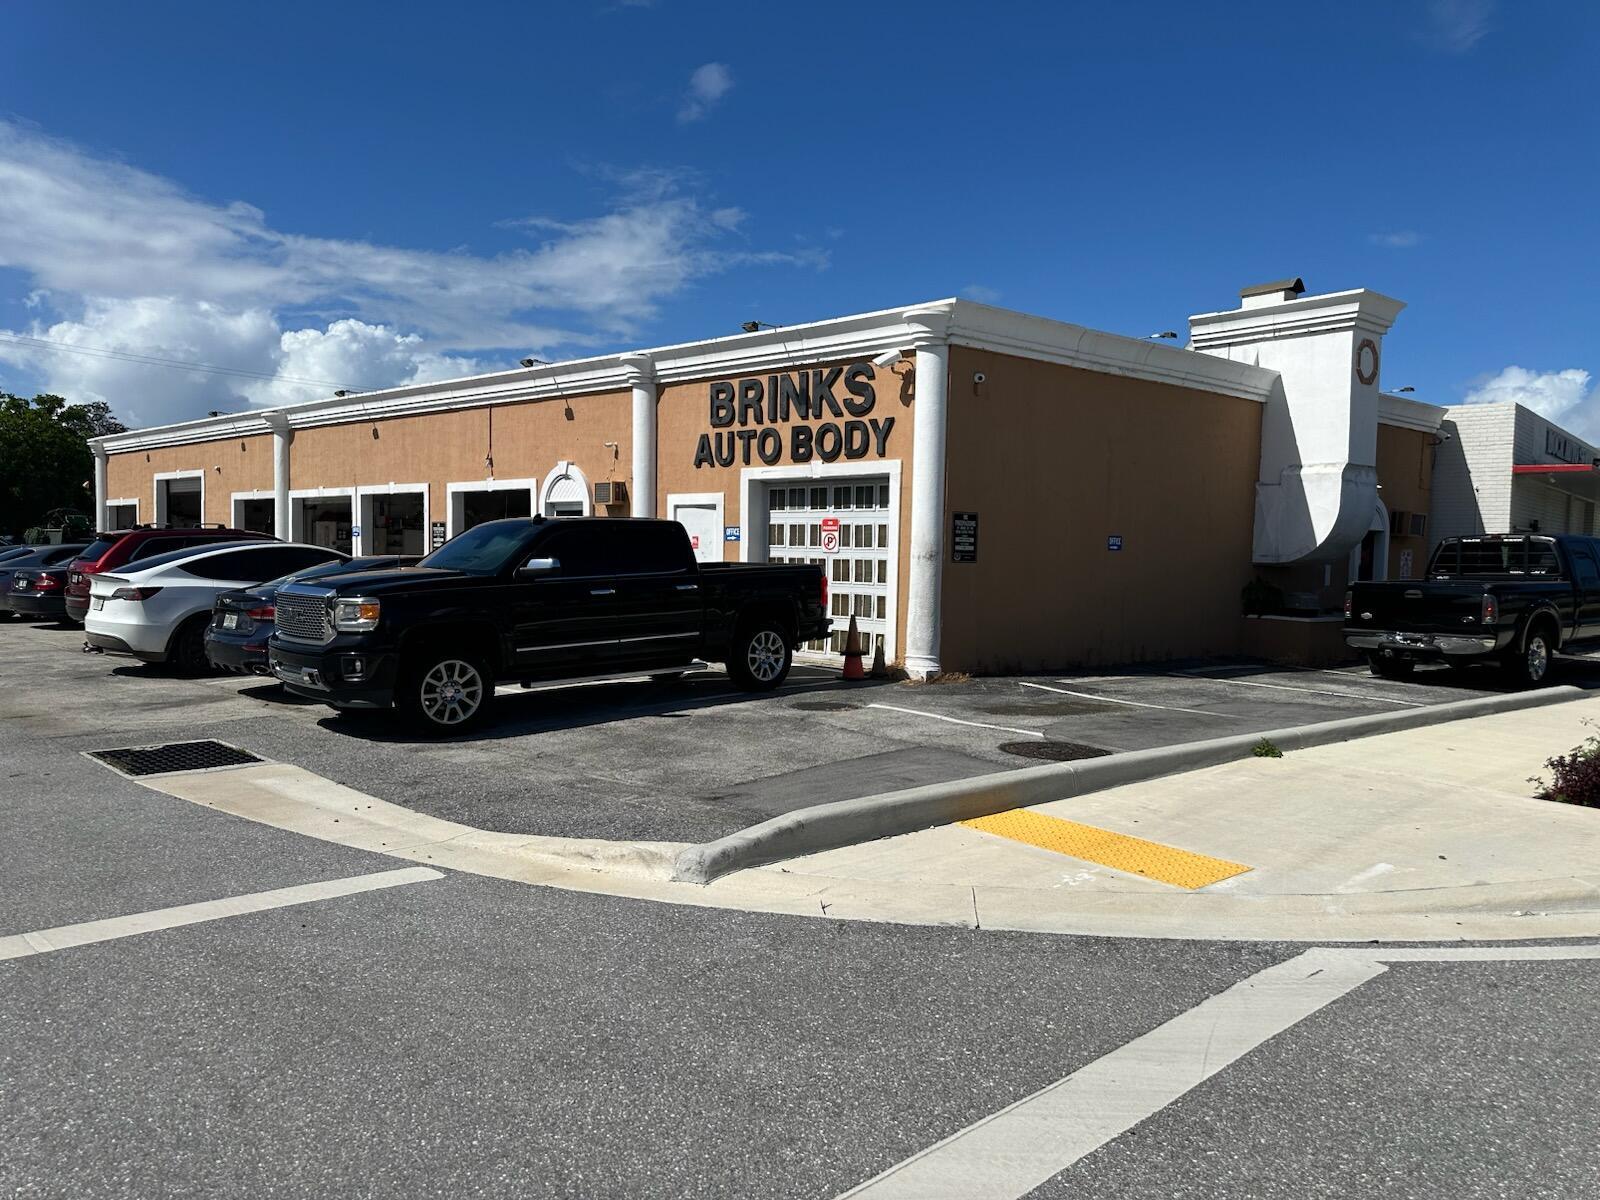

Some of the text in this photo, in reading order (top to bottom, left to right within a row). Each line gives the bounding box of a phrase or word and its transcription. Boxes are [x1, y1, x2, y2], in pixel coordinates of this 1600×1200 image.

[710, 363, 876, 428] BRINKS
[693, 416, 895, 468] AUTO BODY
[726, 527, 740, 536] OFFICE
